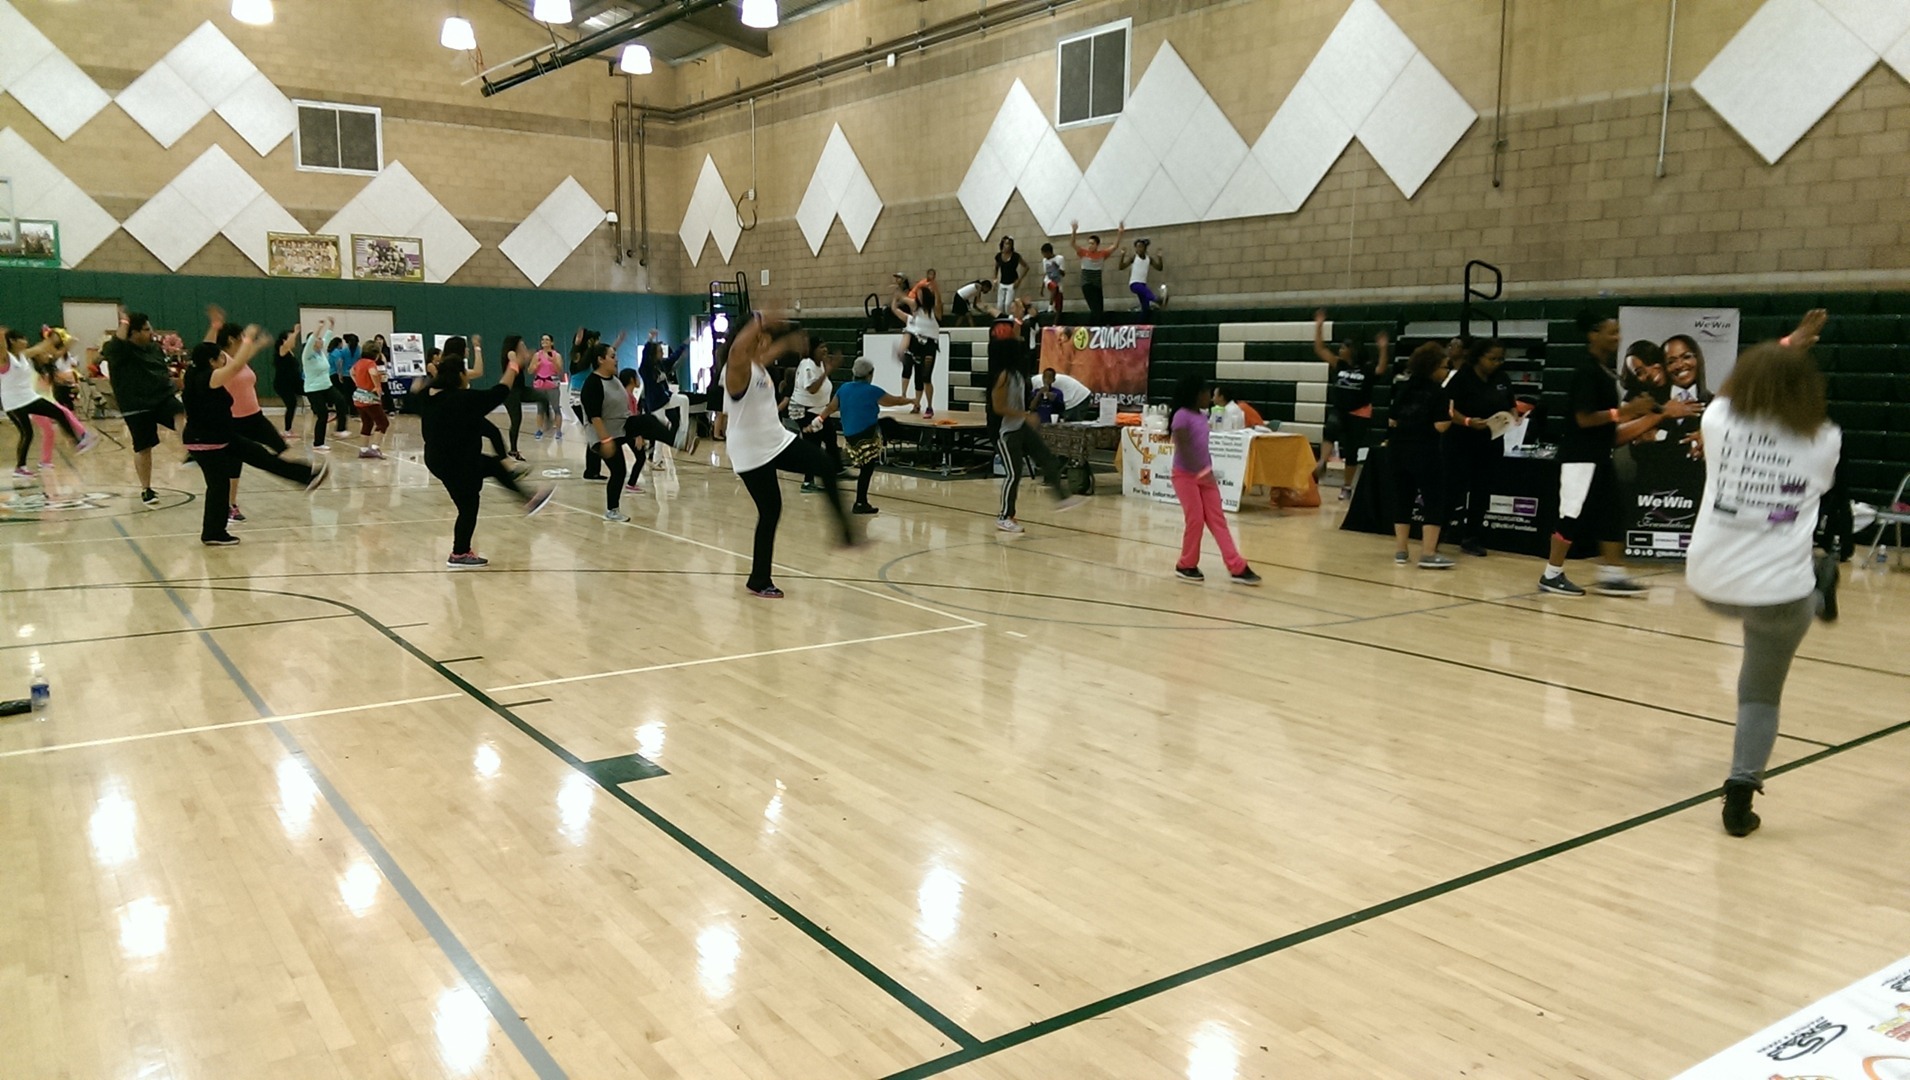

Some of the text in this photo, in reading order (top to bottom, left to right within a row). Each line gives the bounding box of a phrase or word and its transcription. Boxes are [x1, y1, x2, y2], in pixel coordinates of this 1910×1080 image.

[1089, 326, 1136, 350] ZUMBA
[1747, 432, 1777, 447] Life
[1744, 449, 1792, 467] Under
[1737, 481, 1776, 494] Until
[1637, 494, 1693, 509] WeWin
